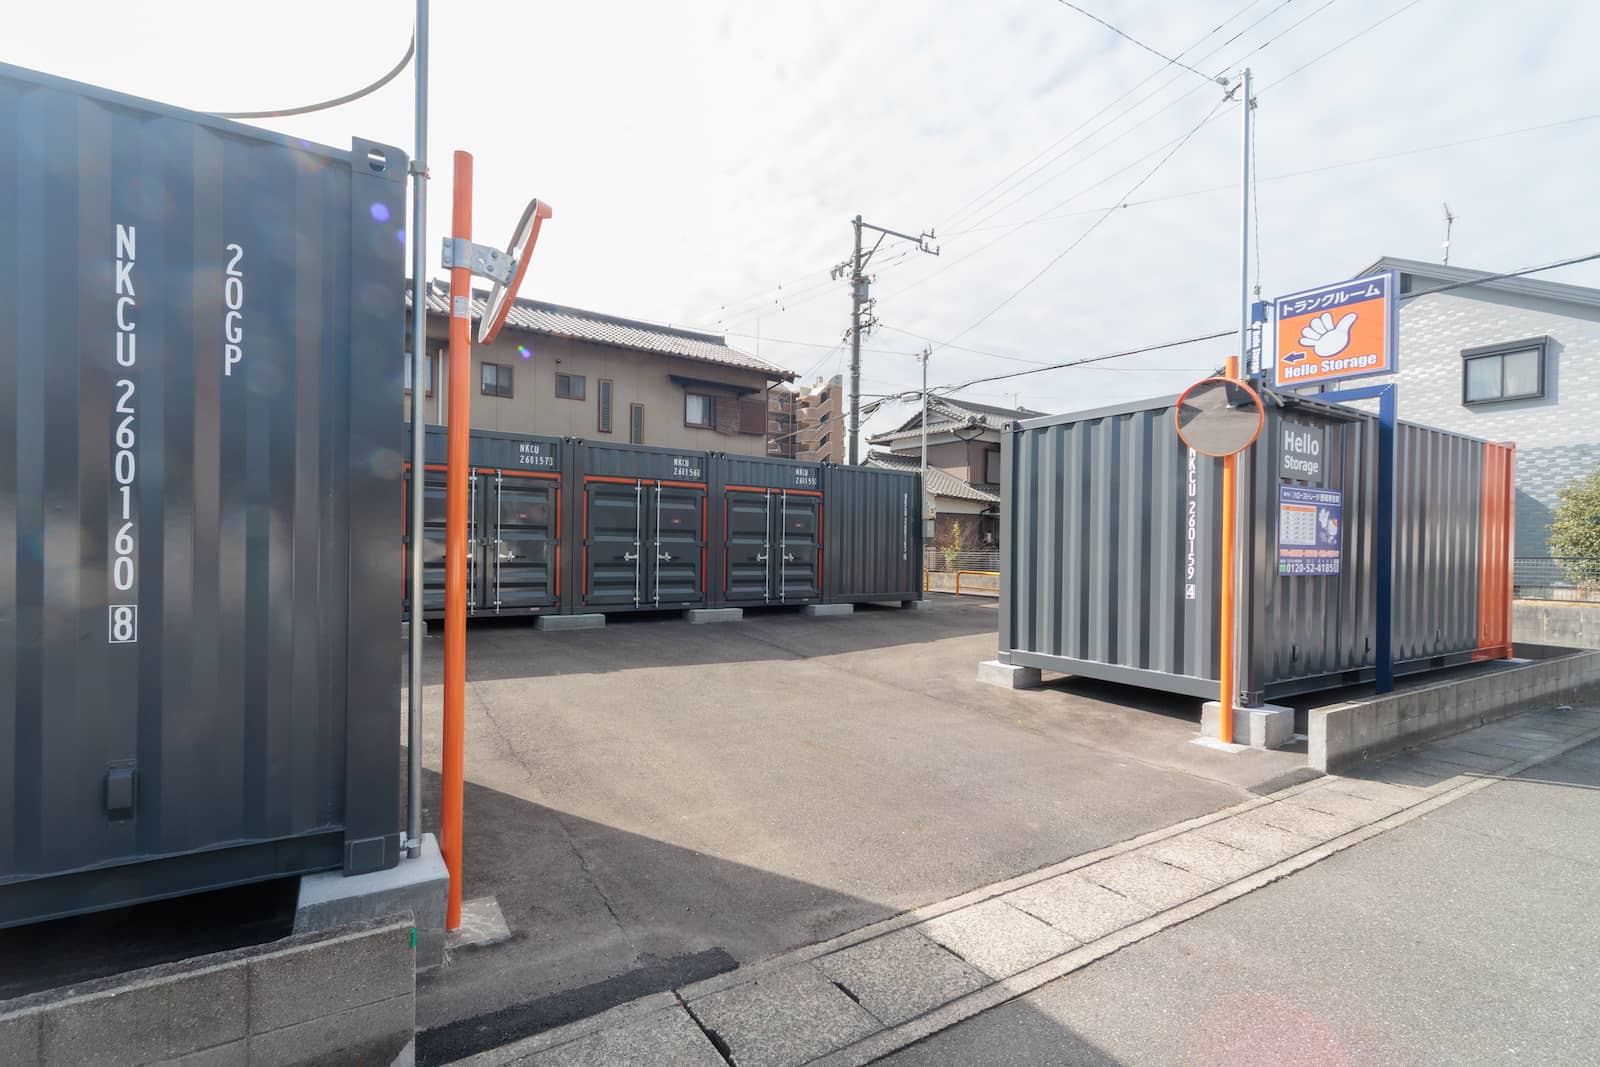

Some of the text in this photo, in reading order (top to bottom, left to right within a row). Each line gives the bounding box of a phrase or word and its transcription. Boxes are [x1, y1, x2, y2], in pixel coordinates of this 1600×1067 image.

[224, 243, 244, 376] 20GP
[1283, 284, 1380, 316] トランクルーム
[1284, 353, 1377, 379] Hello Storage
[112, 223, 136, 642] NKCU 260160 8
[1284, 430, 1319, 456] Hello
[519, 444, 539, 454] NKCU
[1284, 455, 1319, 475] Storage
[1187, 501, 1196, 580] 260159
[1186, 584, 1195, 599] 4
